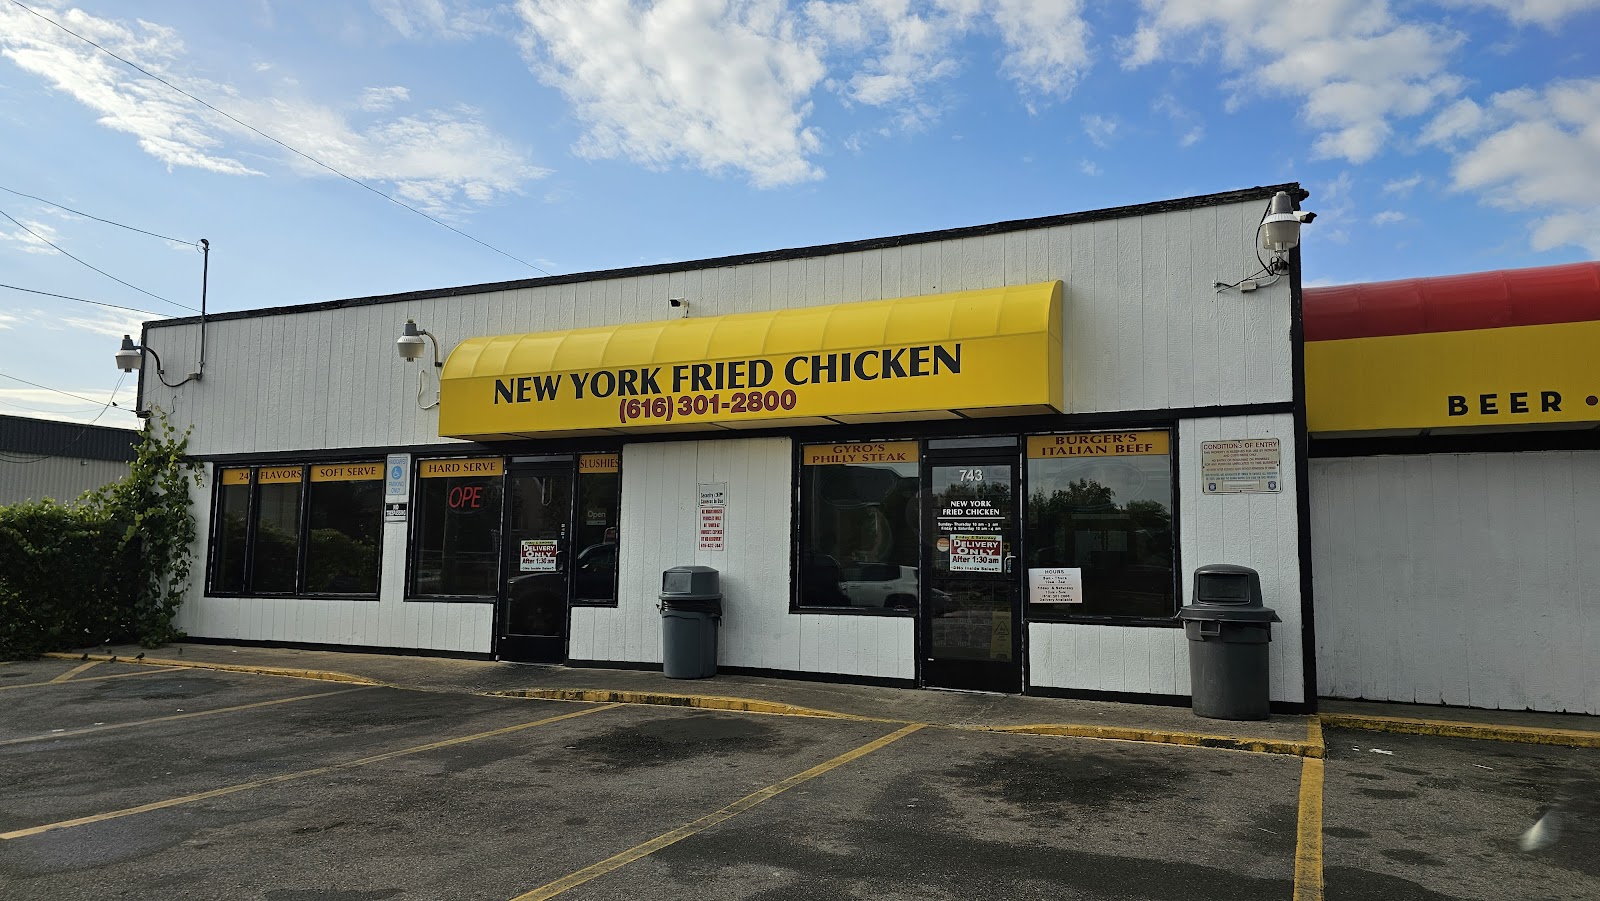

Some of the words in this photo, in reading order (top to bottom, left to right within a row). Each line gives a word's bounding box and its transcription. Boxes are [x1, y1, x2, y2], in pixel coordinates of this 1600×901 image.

[494, 374, 562, 404] NEW
[570, 367, 662, 400] YORK
[672, 359, 774, 393] FRIED
[784, 343, 962, 386] CHICKEN
[619, 396, 674, 424] (616)
[677, 389, 797, 416] 301-2800
[1447, 391, 1562, 417] BEER
[1055, 433, 1137, 445] BURGER'S
[832, 443, 886, 454] GYRO'S
[1042, 445, 1107, 456] ITALIAN
[1115, 443, 1153, 454] BEEF
[580, 458, 619, 469] SLUSHIES
[812, 454, 857, 464] PHILLY
[862, 452, 907, 462] STEAK
[319, 468, 345, 478] SOFT
[347, 466, 377, 477] SERVE
[428, 463, 460, 473] HARD
[463, 461, 497, 472] SERVE
[239, 472, 250, 480] 24
[260, 469, 302, 480] FLAVORS
[959, 469, 983, 482] 743
[950, 500, 968, 508] NEW
[970, 500, 992, 508] YORK
[587, 510, 606, 519] Open
[942, 508, 964, 516] FRIED
[965, 508, 1000, 516] CHICKEN
[953, 539, 999, 548] DELIVERY
[956, 547, 995, 556] ONLY
[952, 555, 970, 563] After
[972, 556, 988, 564] 1:30
